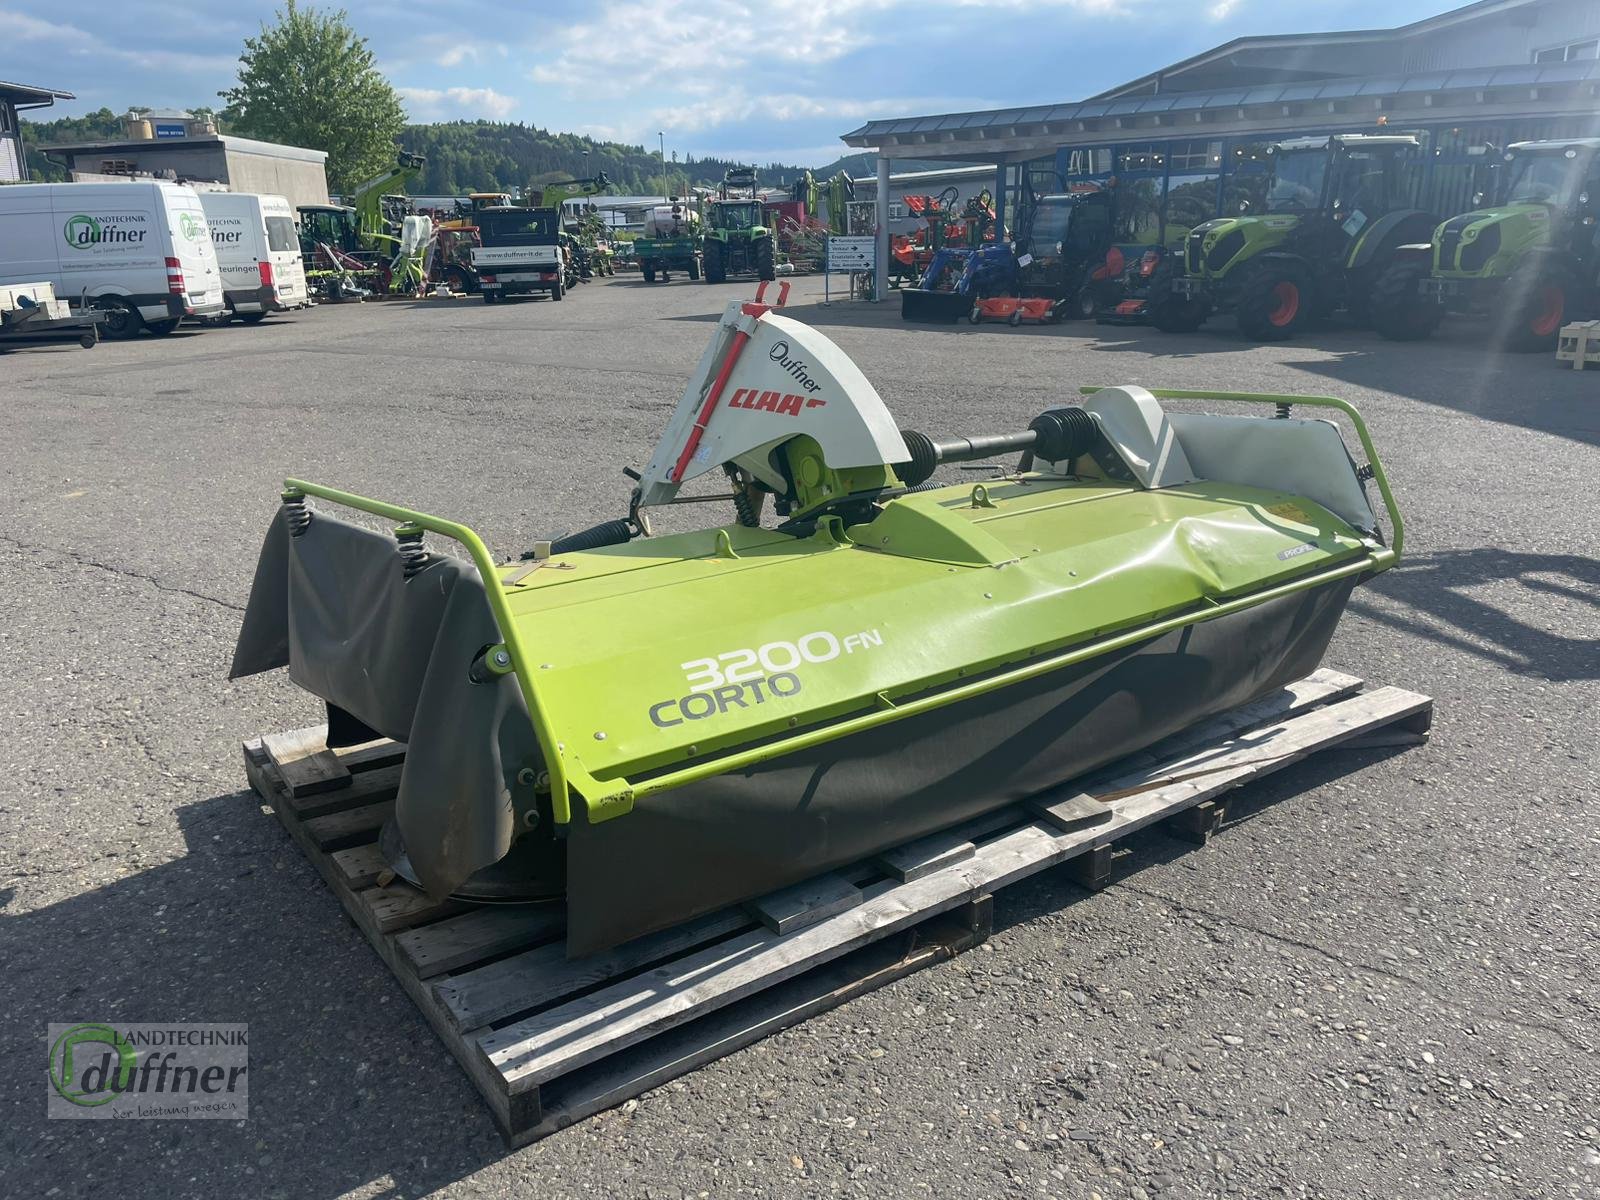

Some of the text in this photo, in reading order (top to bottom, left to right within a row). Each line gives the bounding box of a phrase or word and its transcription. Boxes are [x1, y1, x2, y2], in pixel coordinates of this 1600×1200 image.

[78, 225, 147, 244] duffner
[89, 215, 146, 224] LANDTECHNIK
[769, 340, 821, 393] Duffner
[680, 628, 884, 693] 3200 FN
[648, 672, 801, 728] CORTO
